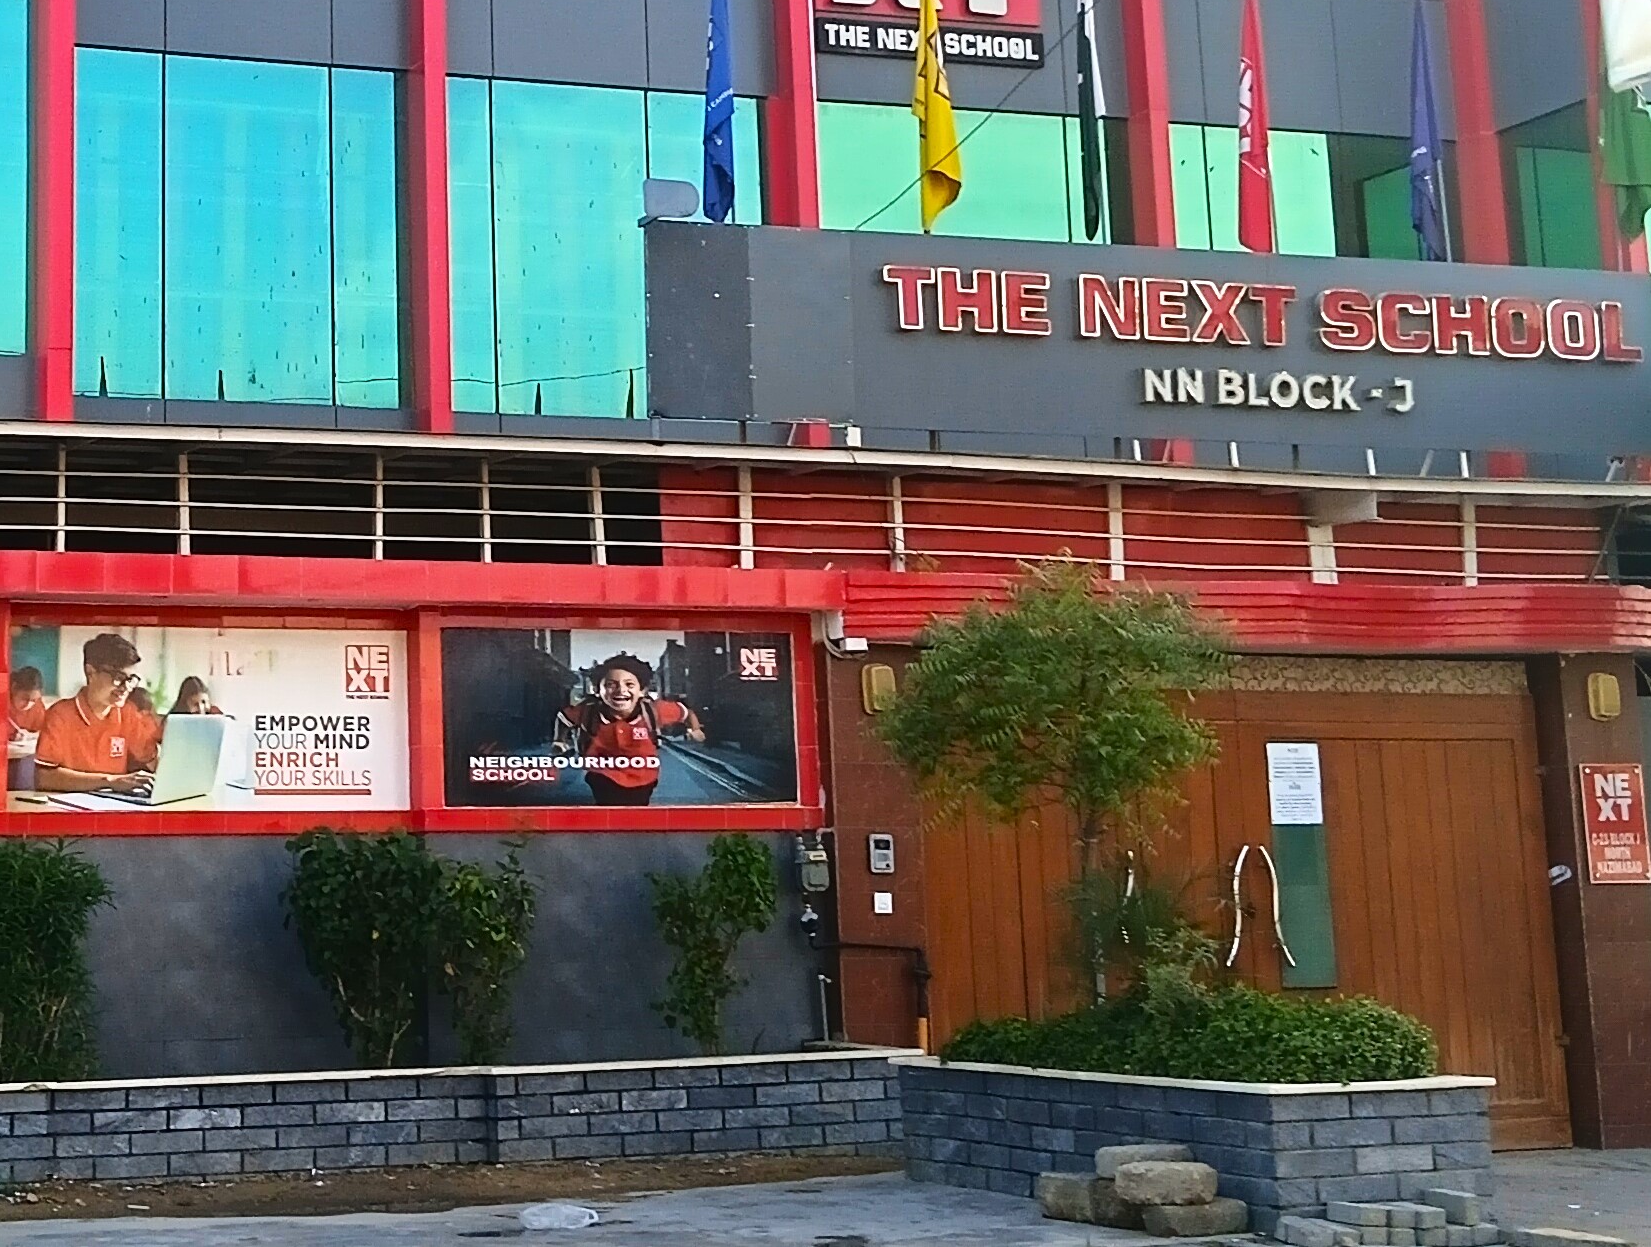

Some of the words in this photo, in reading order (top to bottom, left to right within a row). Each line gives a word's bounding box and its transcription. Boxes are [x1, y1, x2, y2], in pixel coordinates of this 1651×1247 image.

[824, 23, 871, 48] THE
[876, 27, 921, 51] NEX
[944, 33, 1040, 61] SCHOOL
[883, 264, 1051, 336] THE
[1078, 273, 1298, 347] NEXT
[1318, 288, 1645, 363] SCHOOL
[1144, 367, 1205, 404] NN
[1217, 369, 1362, 409] BLOCK
[1389, 376, 1415, 413] J
[254, 715, 371, 732] EMPOWER
[254, 732, 307, 750] YOUR
[314, 733, 370, 750] MIND
[255, 751, 339, 768] ENRICH
[469, 756, 661, 769] NEIGHBOURHOOD
[254, 769, 306, 787] YOUR
[311, 769, 372, 787] SKILLS
[471, 768, 556, 782] SCHOOL
